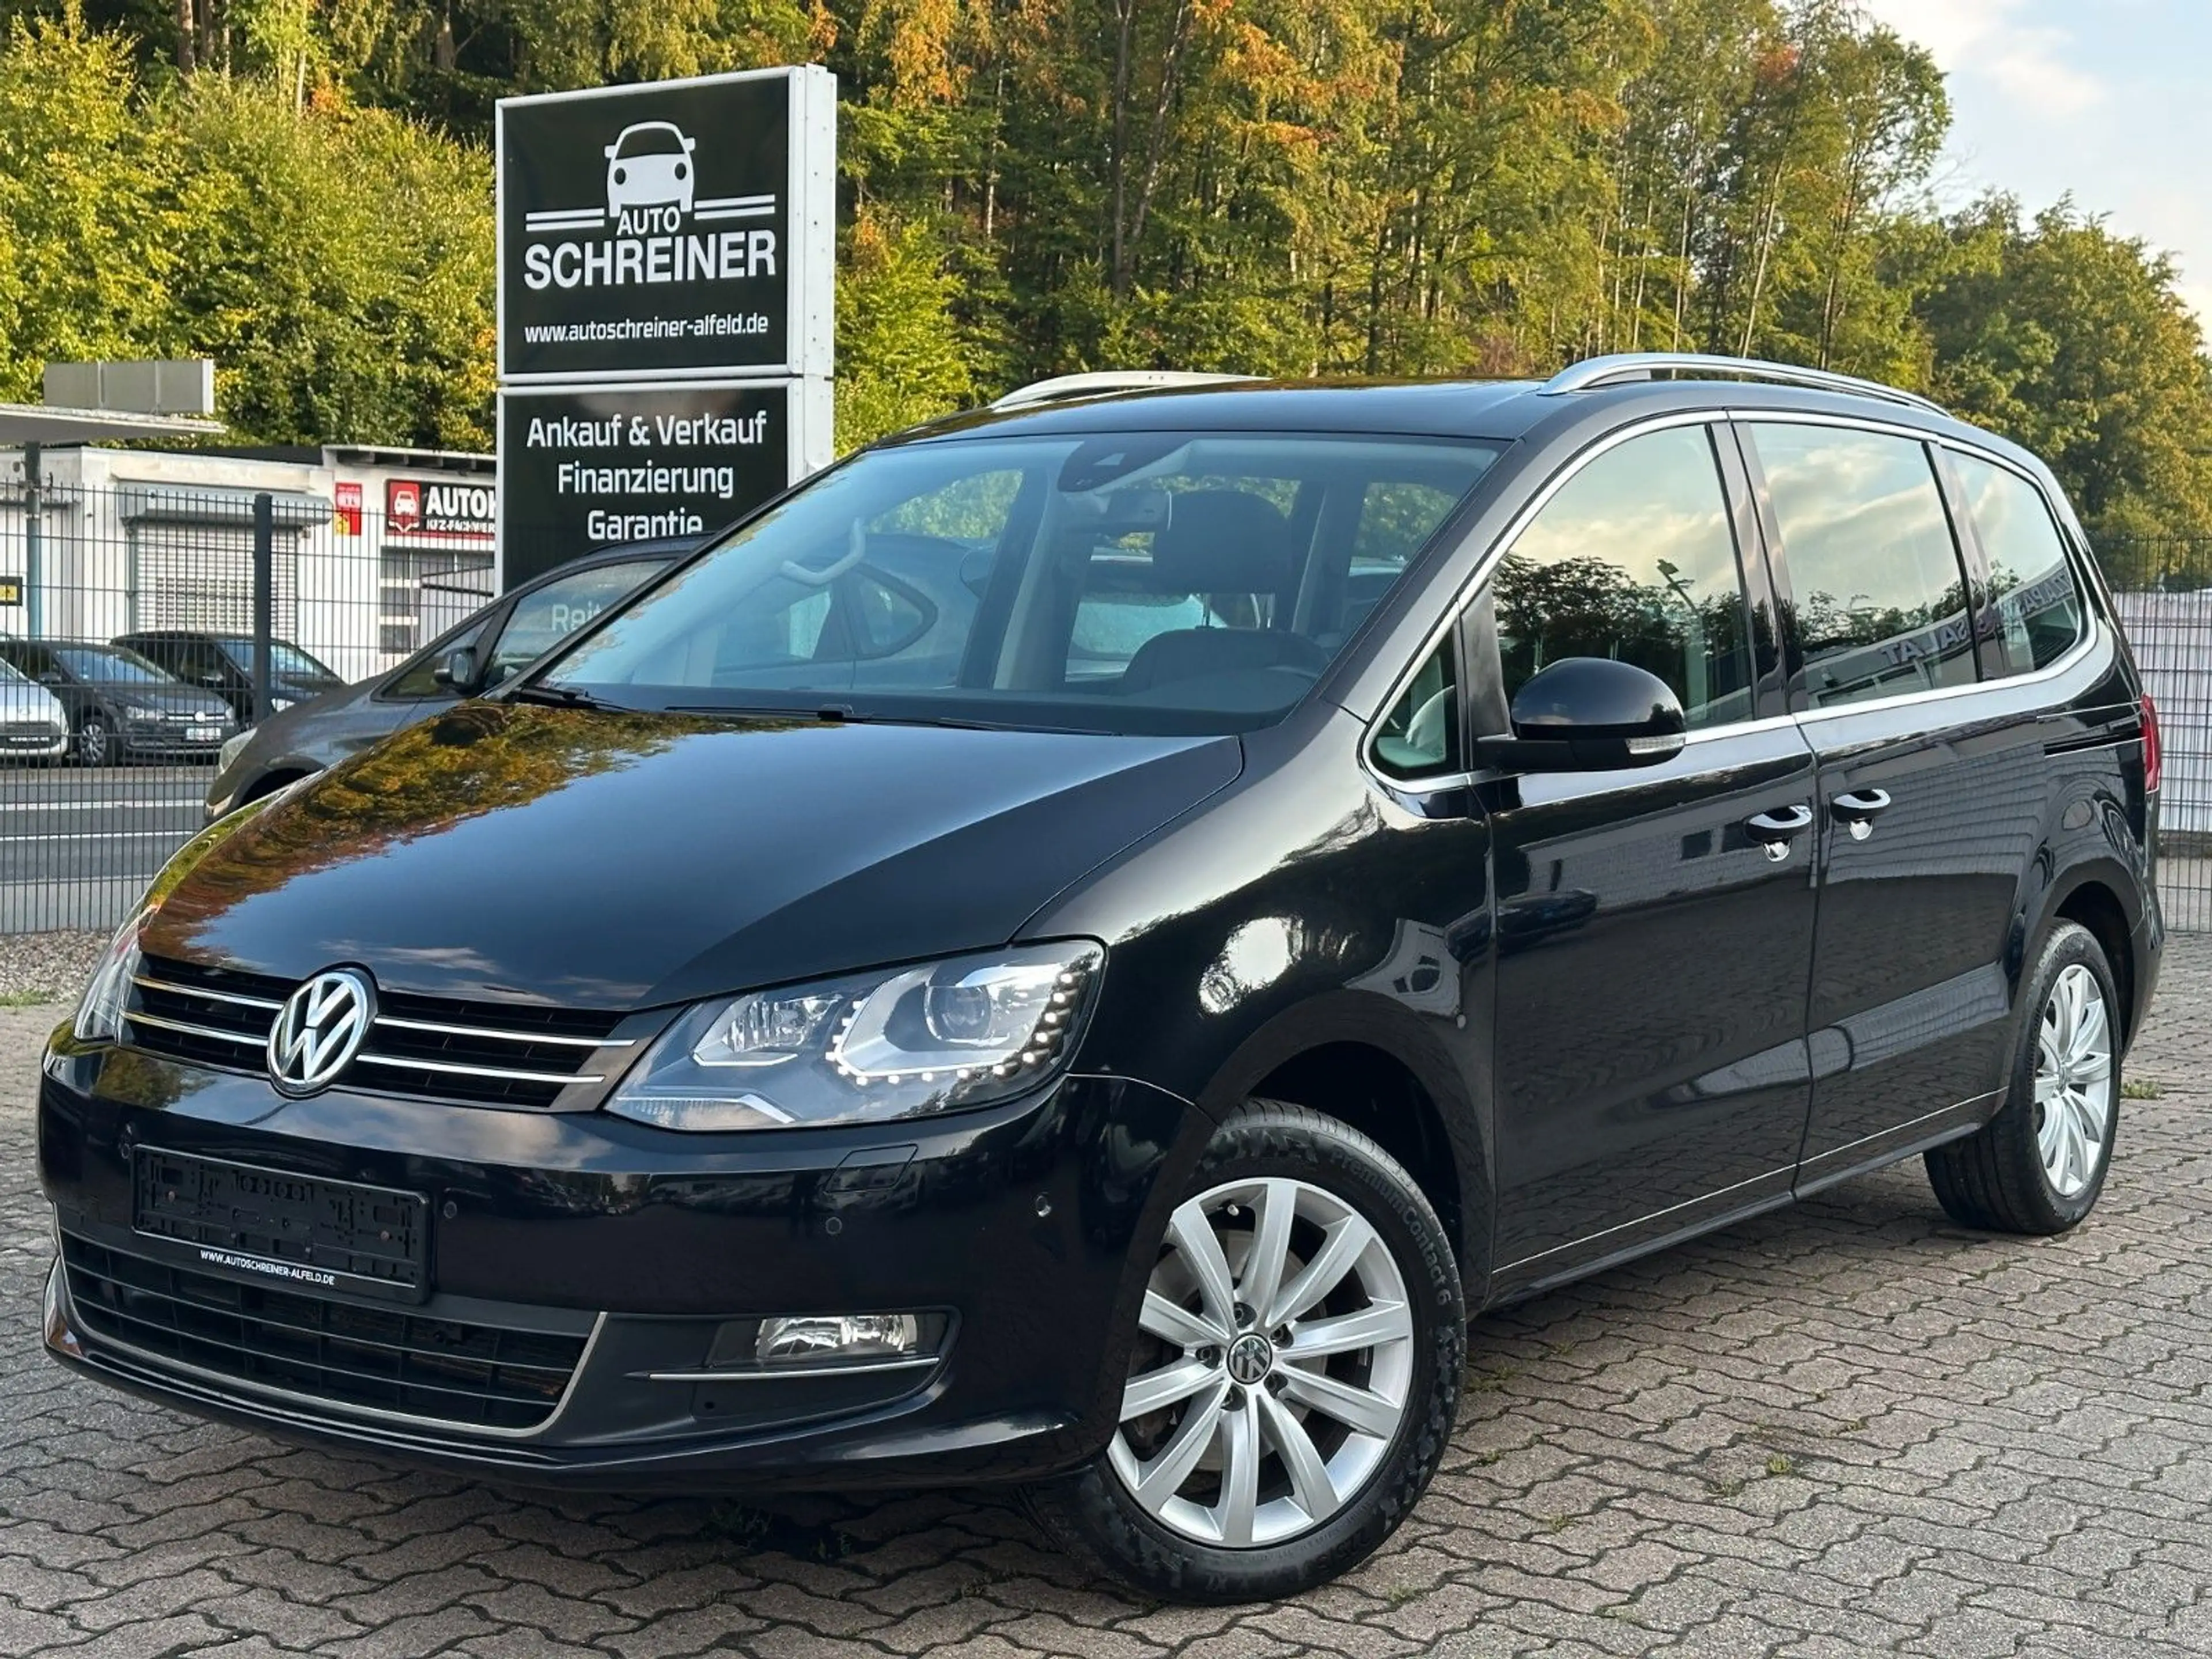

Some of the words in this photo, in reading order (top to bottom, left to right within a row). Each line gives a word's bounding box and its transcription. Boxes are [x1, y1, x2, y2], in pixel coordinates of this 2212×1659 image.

[616, 205, 681, 236] AUTO
[524, 230, 777, 289] SCHREINER
[525, 313, 768, 343] www.autoschreiner-alfeld.de
[527, 414, 622, 448] Ankauf
[628, 415, 651, 446] &
[656, 410, 767, 446] Verkauf
[558, 460, 734, 498] Finanzierung
[588, 507, 703, 540] Garantie
[200, 1249, 335, 1286] WWW.AUTOSCHREINER-ALFELD.DE
